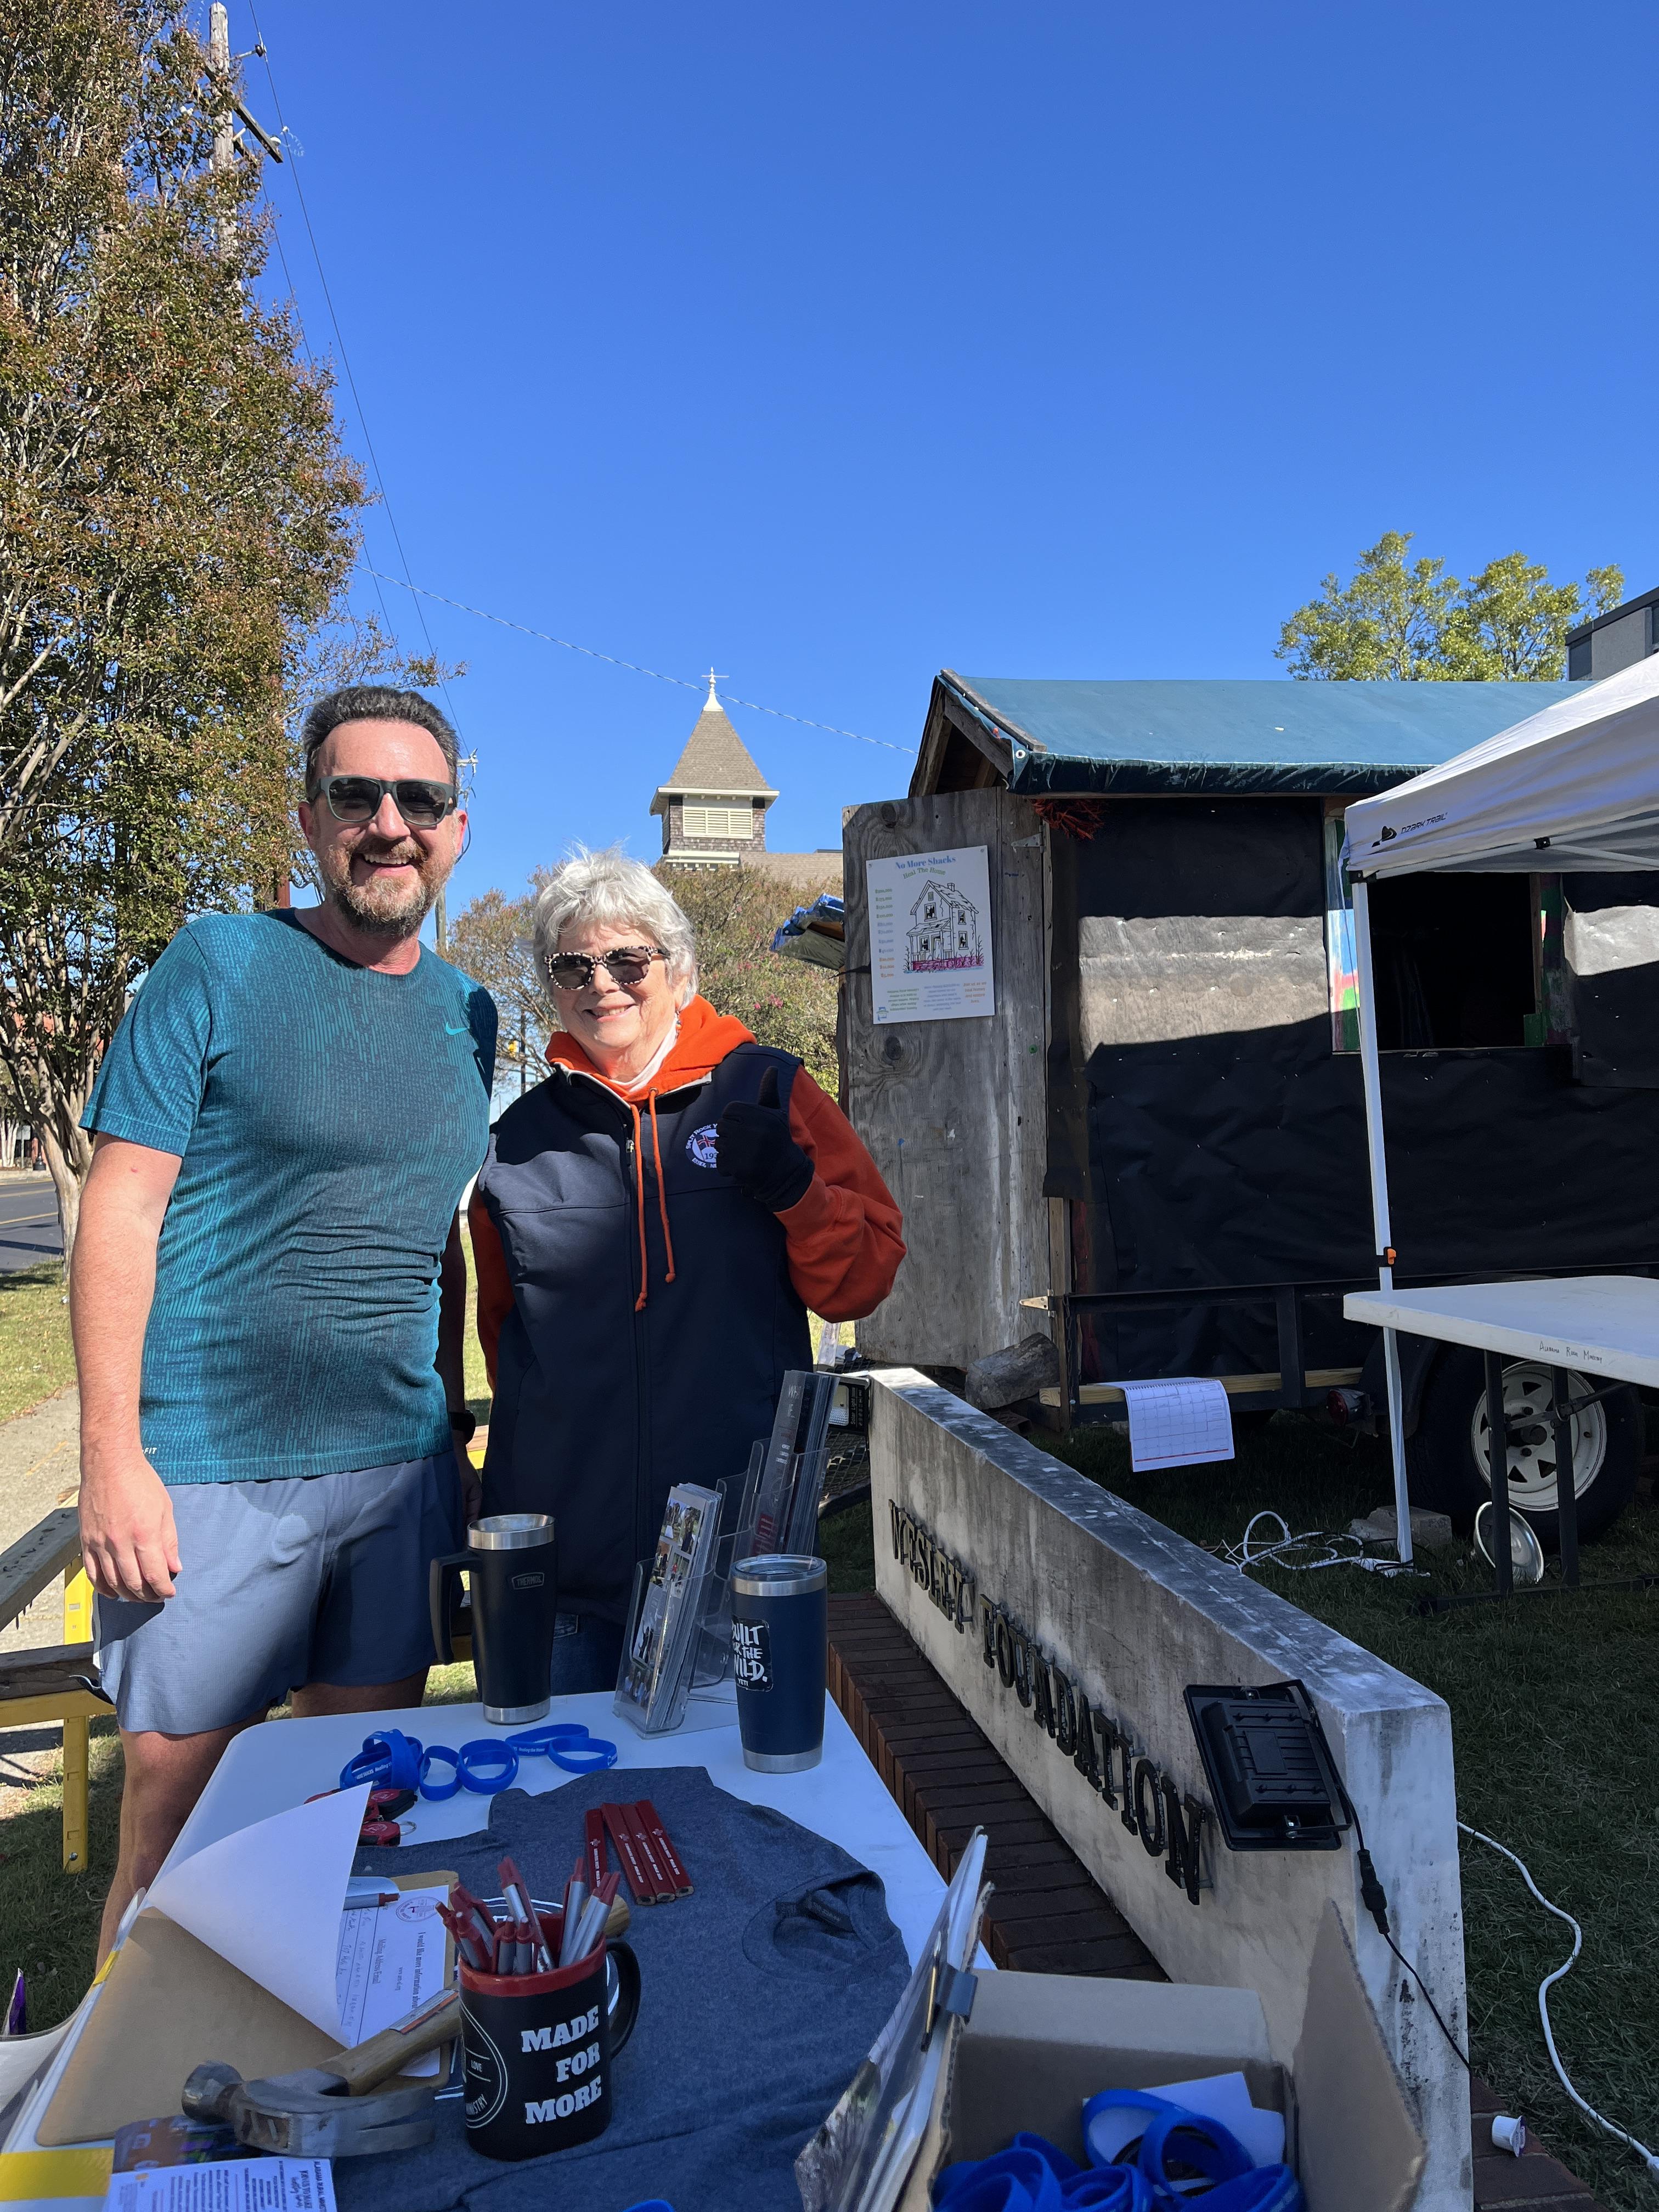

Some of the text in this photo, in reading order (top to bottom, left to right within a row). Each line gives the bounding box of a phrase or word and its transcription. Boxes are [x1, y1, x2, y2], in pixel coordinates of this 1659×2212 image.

[895, 861, 905, 870] No
[928, 855, 956, 866] Shacks
[903, 870, 916, 879] Heal
[930, 867, 946, 876] Home
[685, 1133, 695, 1149] SPLIT
[693, 1124, 712, 1135] ROCK
[516, 1575, 541, 1587] THERMOS
[742, 1646, 763, 1659] THE
[737, 1678, 749, 1687] YETI
[888, 1498, 967, 1634] WESLEY
[980, 1593, 1206, 1905] FOUNDATION
[416, 1935, 425, 1948] would
[416, 1948, 425, 1956] like
[413, 1968, 423, 1995] information
[522, 2005, 599, 2052] MADE
[471, 2060, 483, 2073] LOVE
[556, 2041, 601, 2083] FOR
[525, 2074, 602, 2124] MORE
